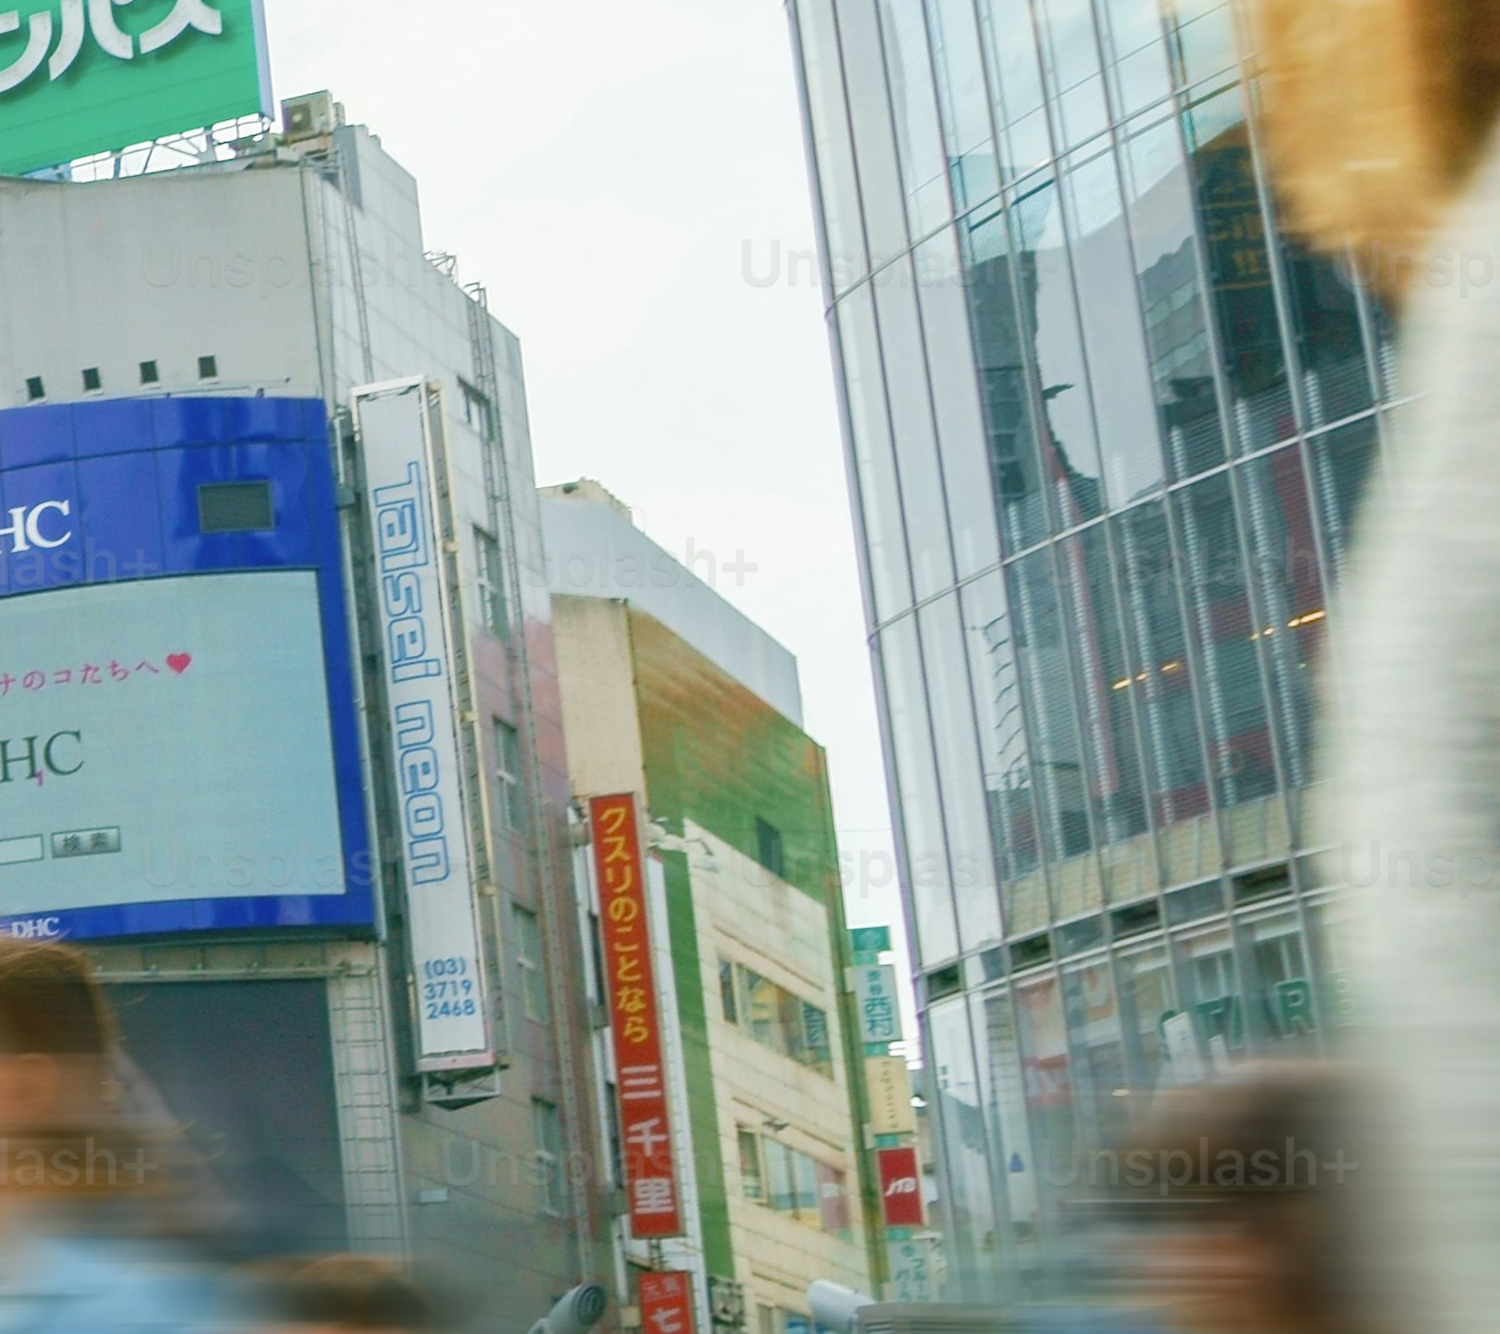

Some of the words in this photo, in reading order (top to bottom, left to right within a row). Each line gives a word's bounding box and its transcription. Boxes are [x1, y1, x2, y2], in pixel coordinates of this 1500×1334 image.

[373, 459, 443, 686] Taisei
[394, 701, 450, 887] neon
[10, 916, 61, 941] DHC
[423, 957, 467, 979] (03)
[599, 805, 650, 1045] クスリのことなら
[423, 978, 474, 1000] 3719
[425, 998, 477, 1021] 2468
[620, 1064, 675, 1217] 三千里
